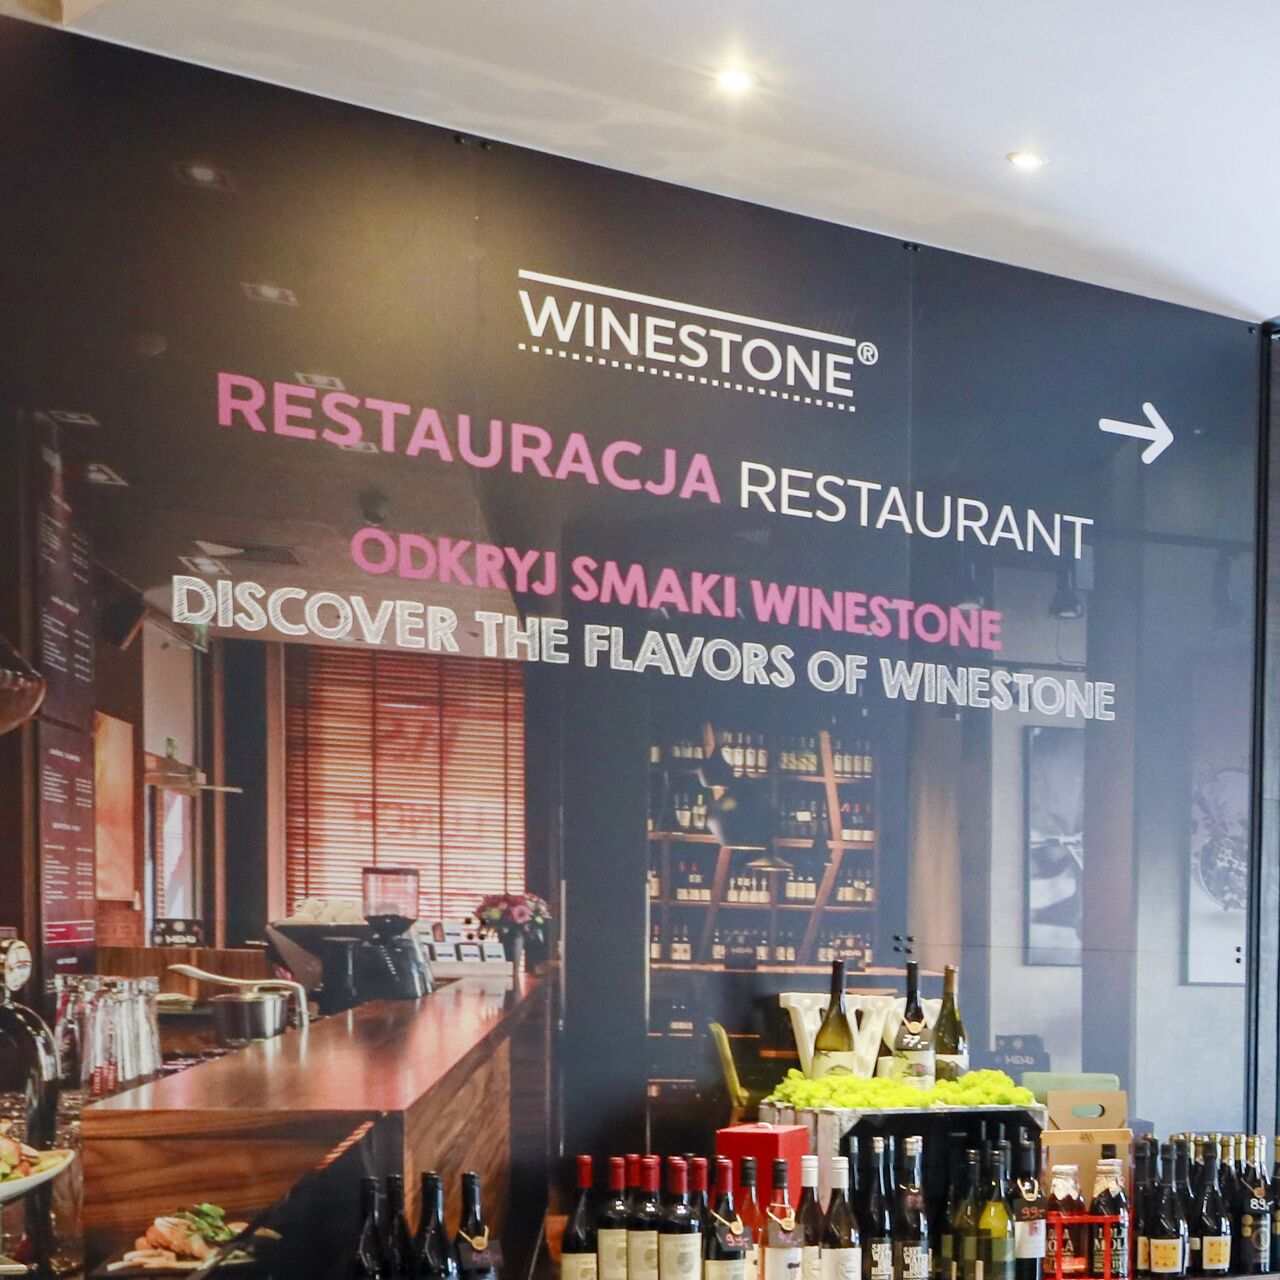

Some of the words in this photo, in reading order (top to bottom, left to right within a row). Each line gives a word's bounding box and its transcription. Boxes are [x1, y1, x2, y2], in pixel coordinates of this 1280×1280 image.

[217, 371, 722, 504] RESTAURACJA
[740, 461, 1094, 560] RESTAURANT
[172, 575, 460, 653] DISCOVER
[474, 610, 569, 664] THE
[583, 624, 795, 688] FLAVORS
[807, 650, 868, 694] OF
[879, 657, 1116, 722] WINESTONE
[350, 528, 558, 596] ODKRYJ
[571, 555, 737, 618] SMAKI
[751, 580, 1004, 651] WINESTONE
